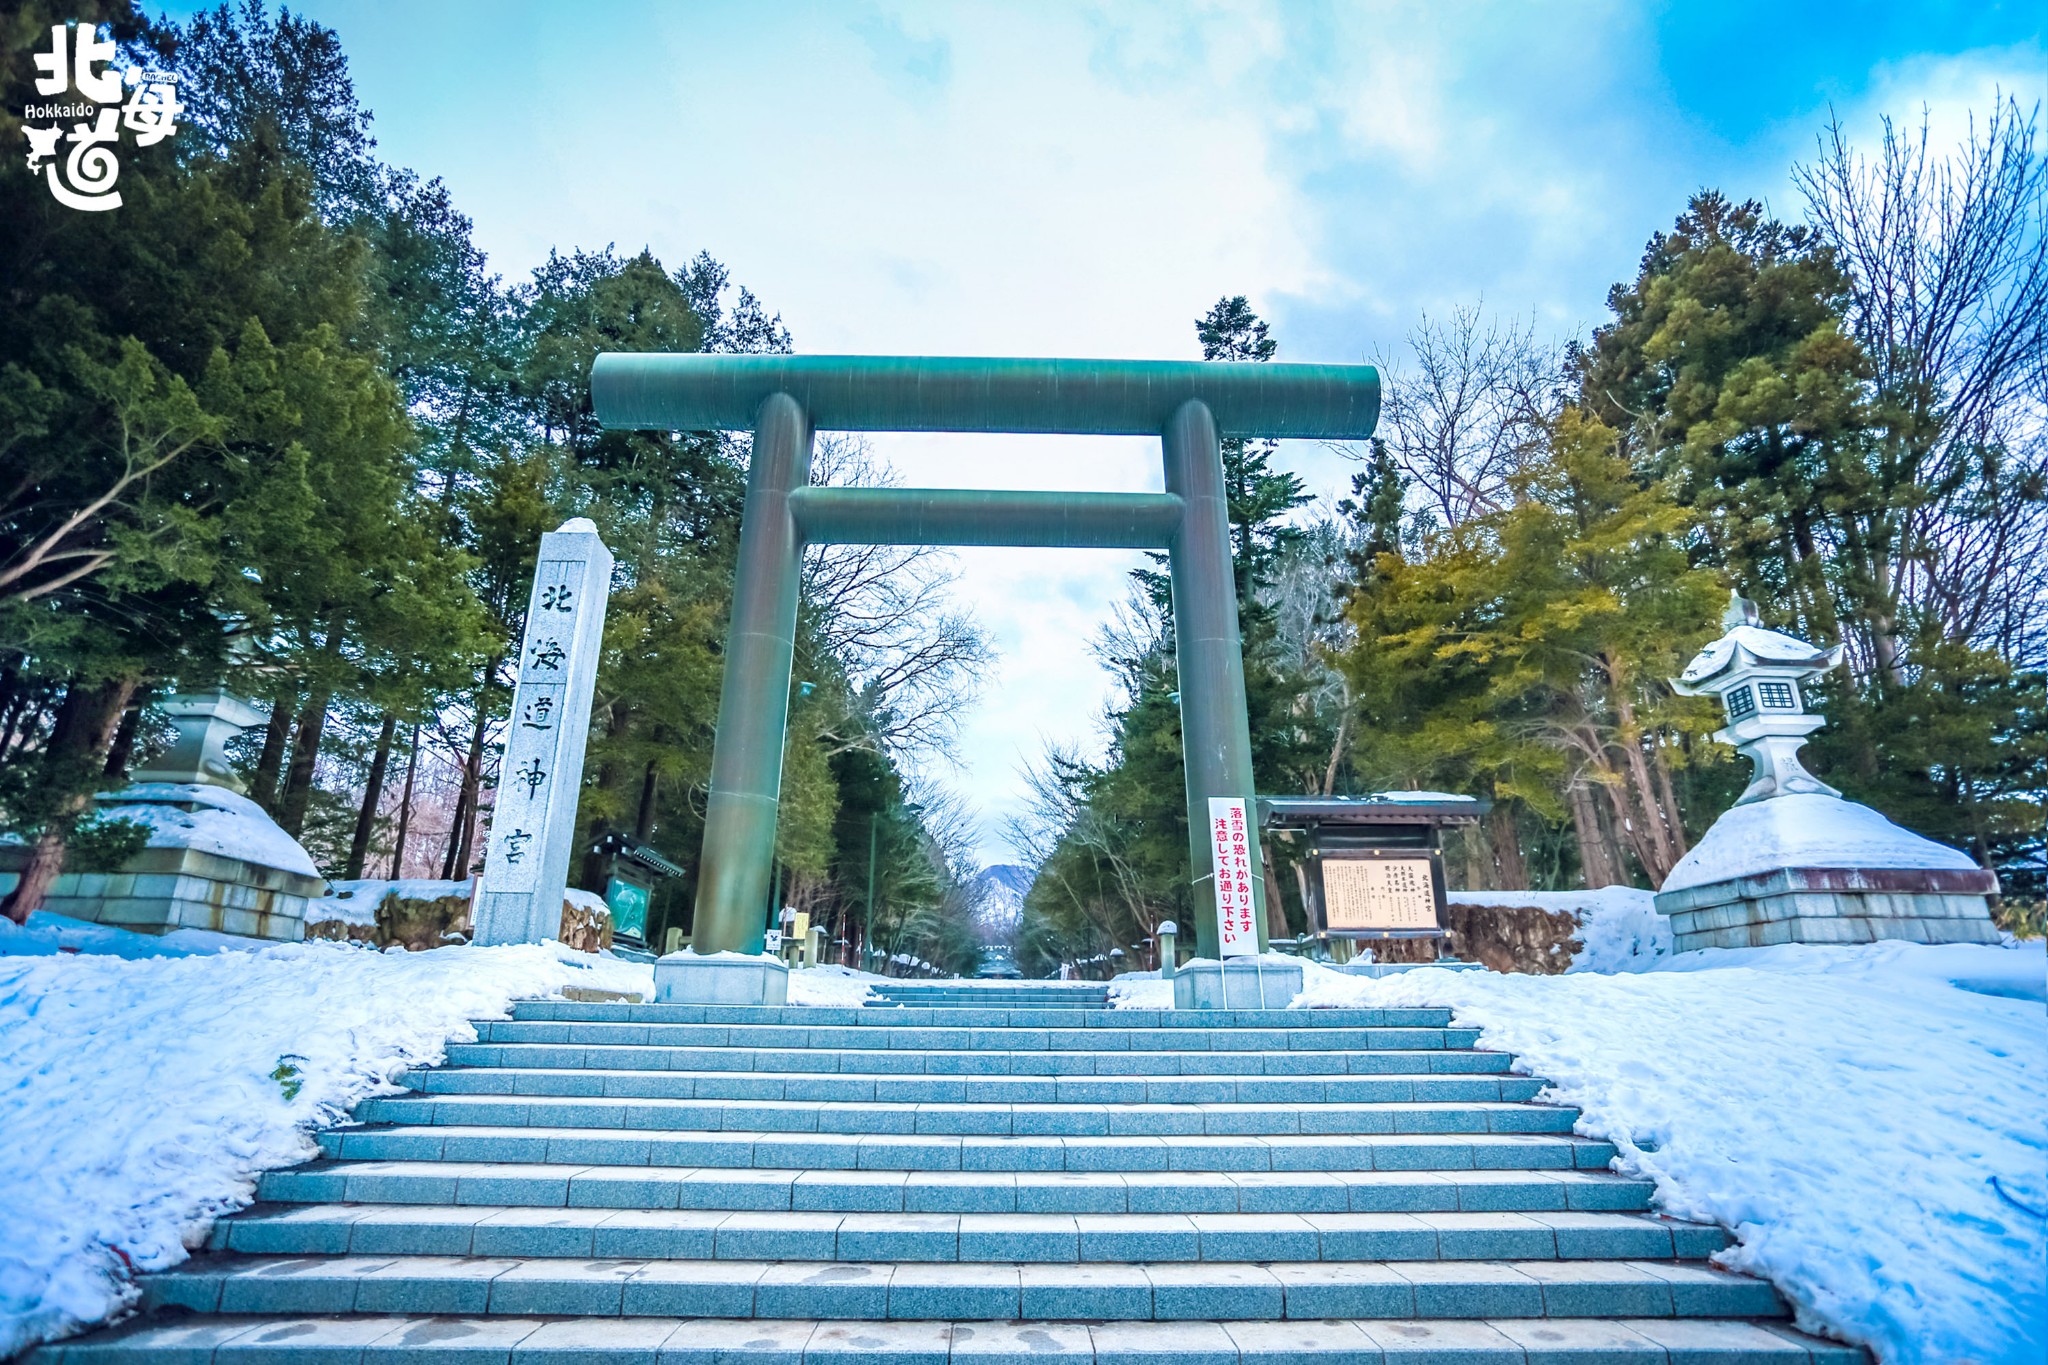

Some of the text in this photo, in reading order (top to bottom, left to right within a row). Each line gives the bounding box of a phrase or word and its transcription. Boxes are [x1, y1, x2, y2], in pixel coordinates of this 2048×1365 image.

[503, 583, 573, 865] 北海道神宮
[1215, 818, 1236, 943] 注意してお通り下さい
[1230, 807, 1252, 932] 落雪の恐れがあります
